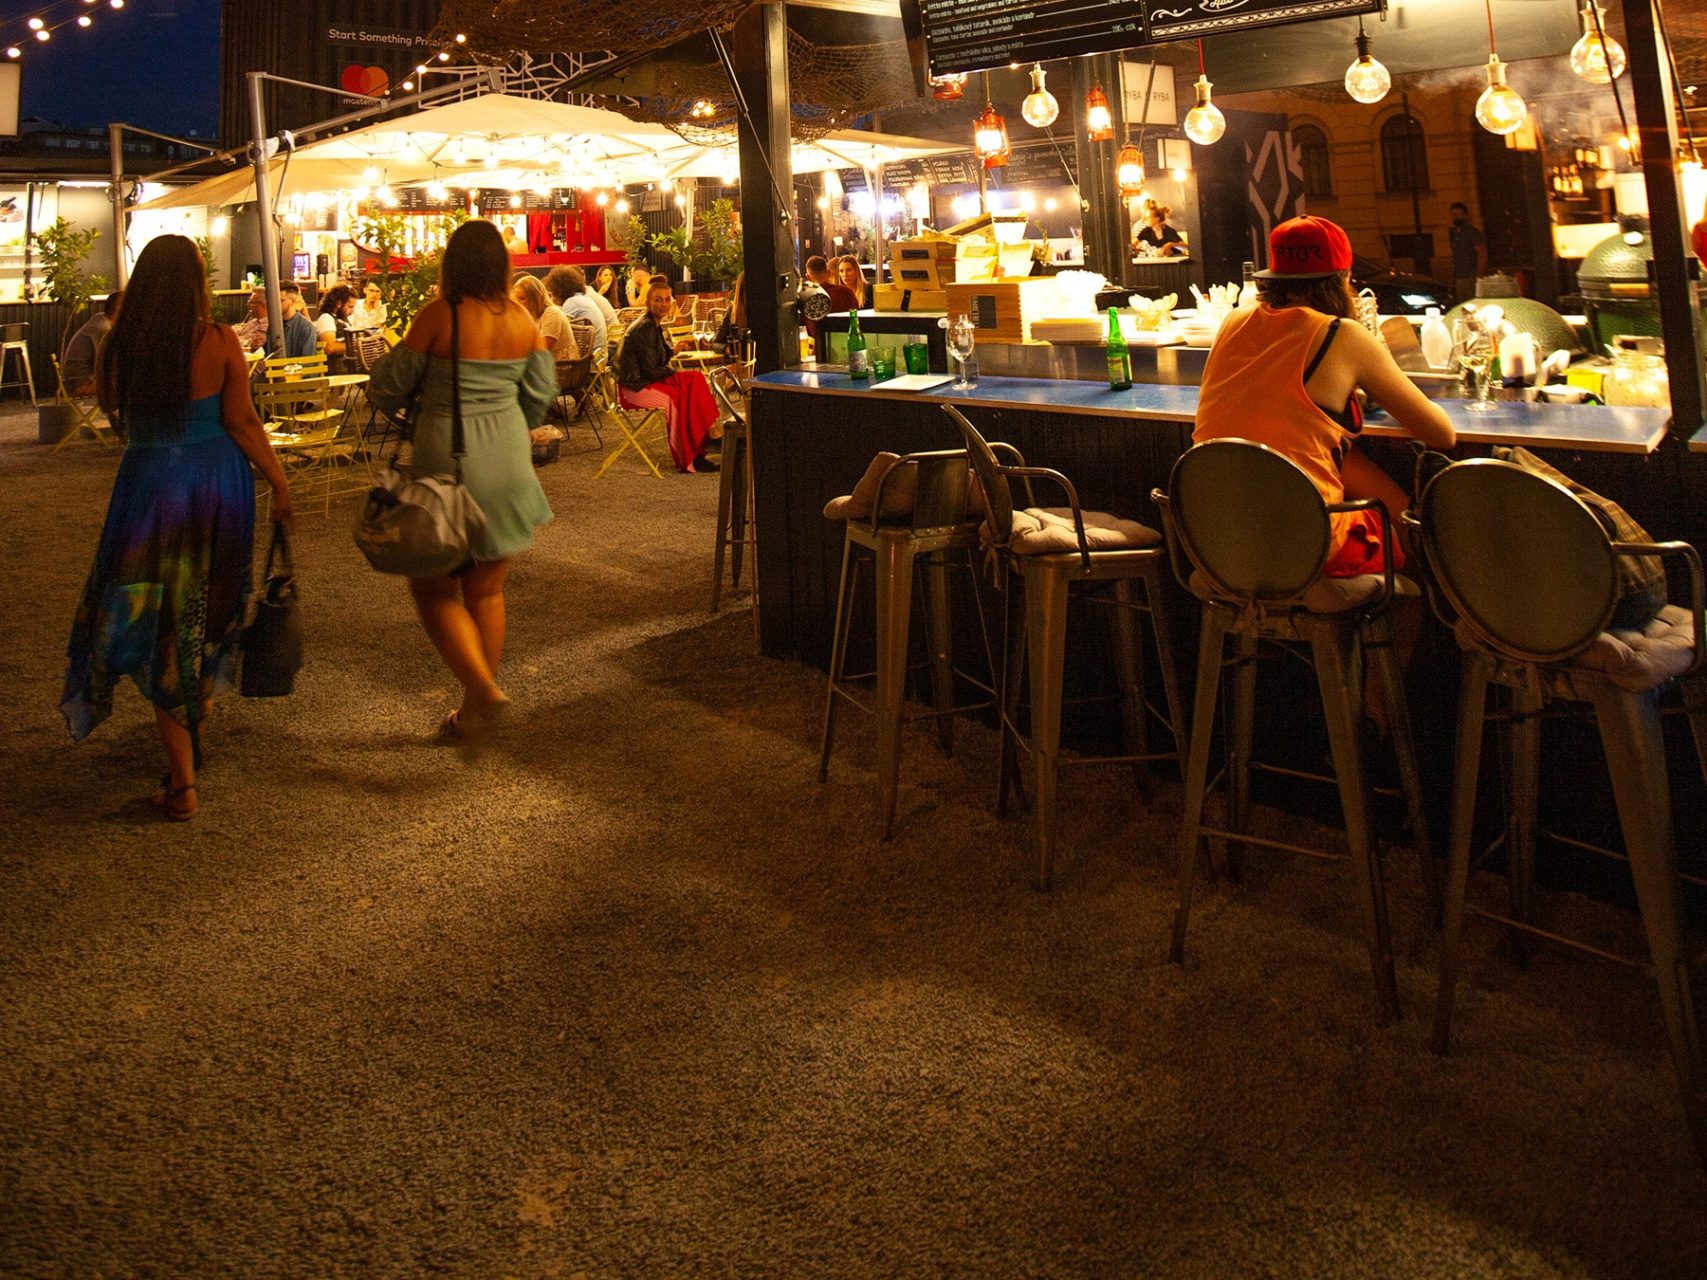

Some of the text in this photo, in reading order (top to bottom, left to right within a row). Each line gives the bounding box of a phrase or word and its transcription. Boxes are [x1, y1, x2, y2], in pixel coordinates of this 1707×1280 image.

[328, 28, 357, 41] Start
[359, 31, 412, 48] Something
[1152, 90, 1170, 102] RYBA
